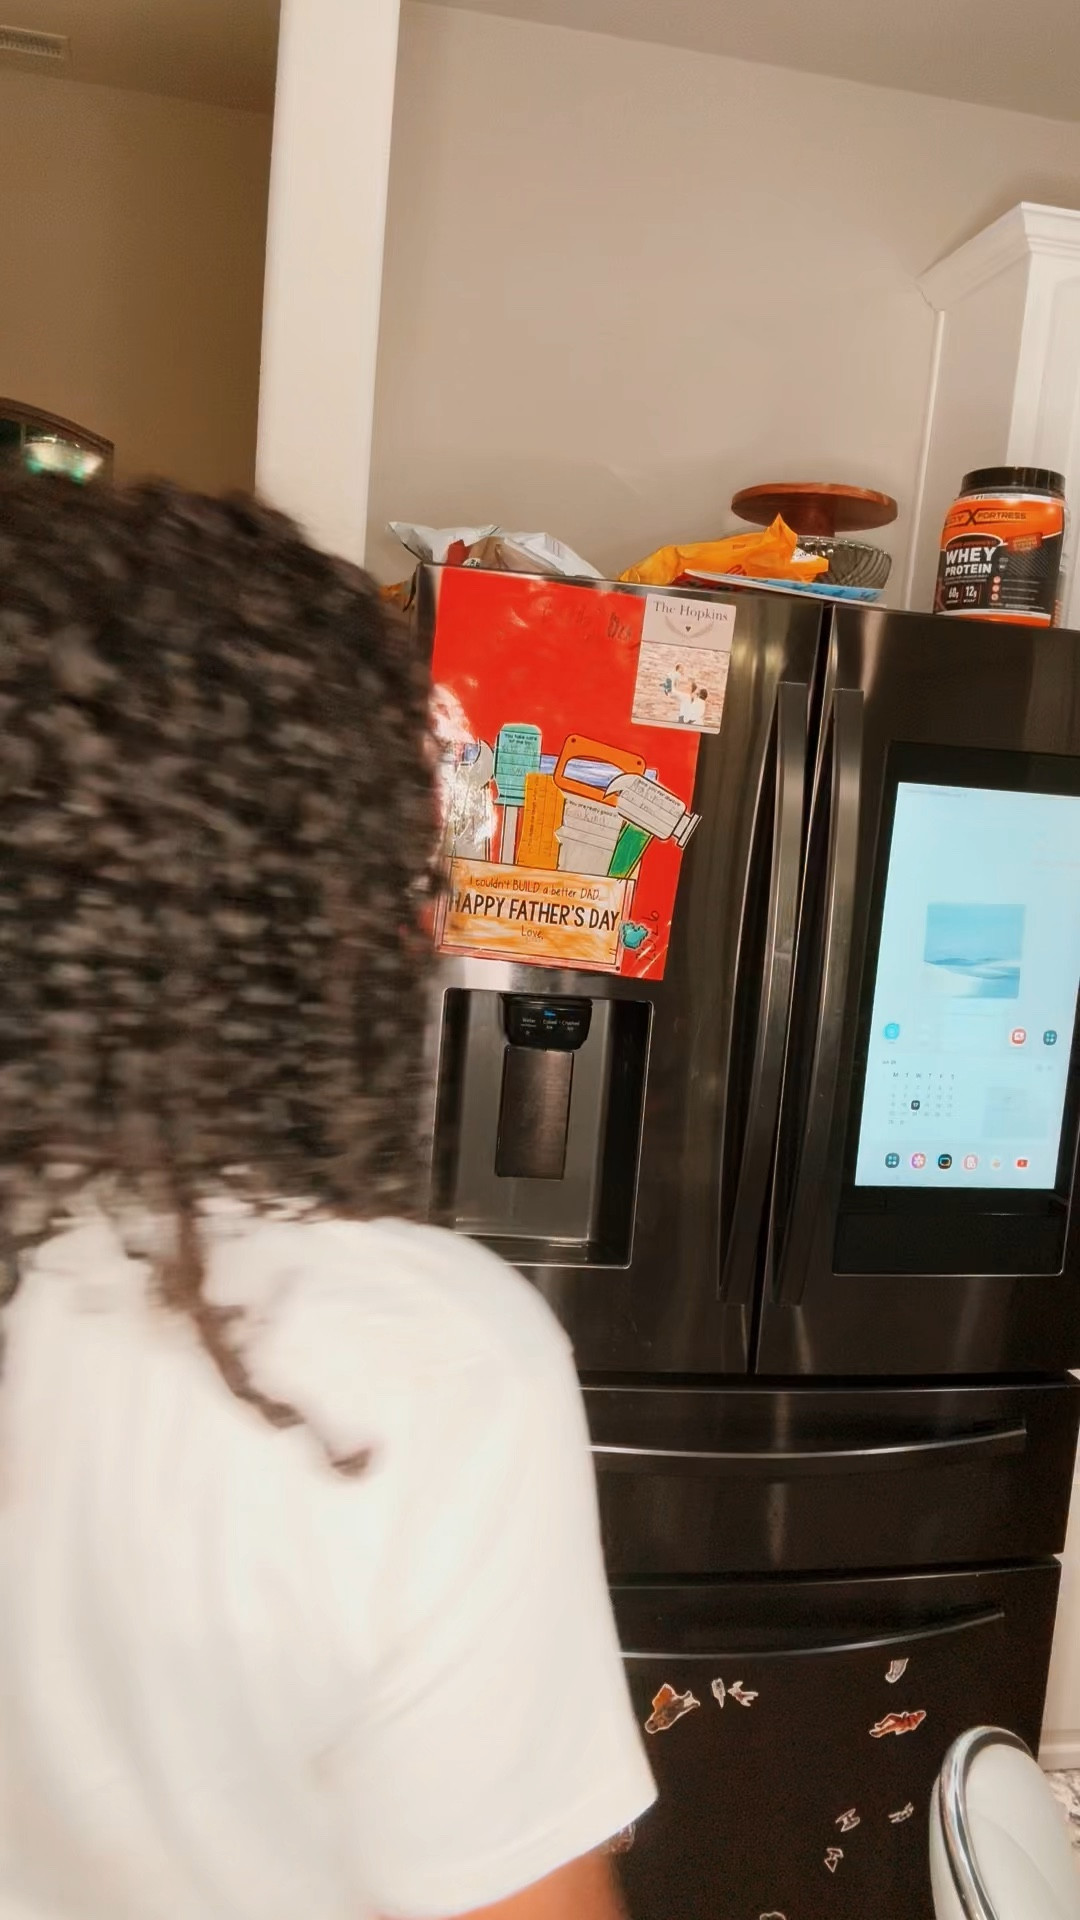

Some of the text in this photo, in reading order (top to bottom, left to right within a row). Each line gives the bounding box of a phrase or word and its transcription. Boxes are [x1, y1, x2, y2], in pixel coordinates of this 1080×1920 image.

[946, 547, 996, 565] WHEY
[945, 564, 992, 576] PROTEIN
[655, 601, 728, 621] The Hopkins
[475, 878, 511, 889] couldn't
[512, 879, 540, 893] BUILD
[552, 887, 576, 898] better
[449, 892, 620, 931] HAPPY FATHER'S DAY
